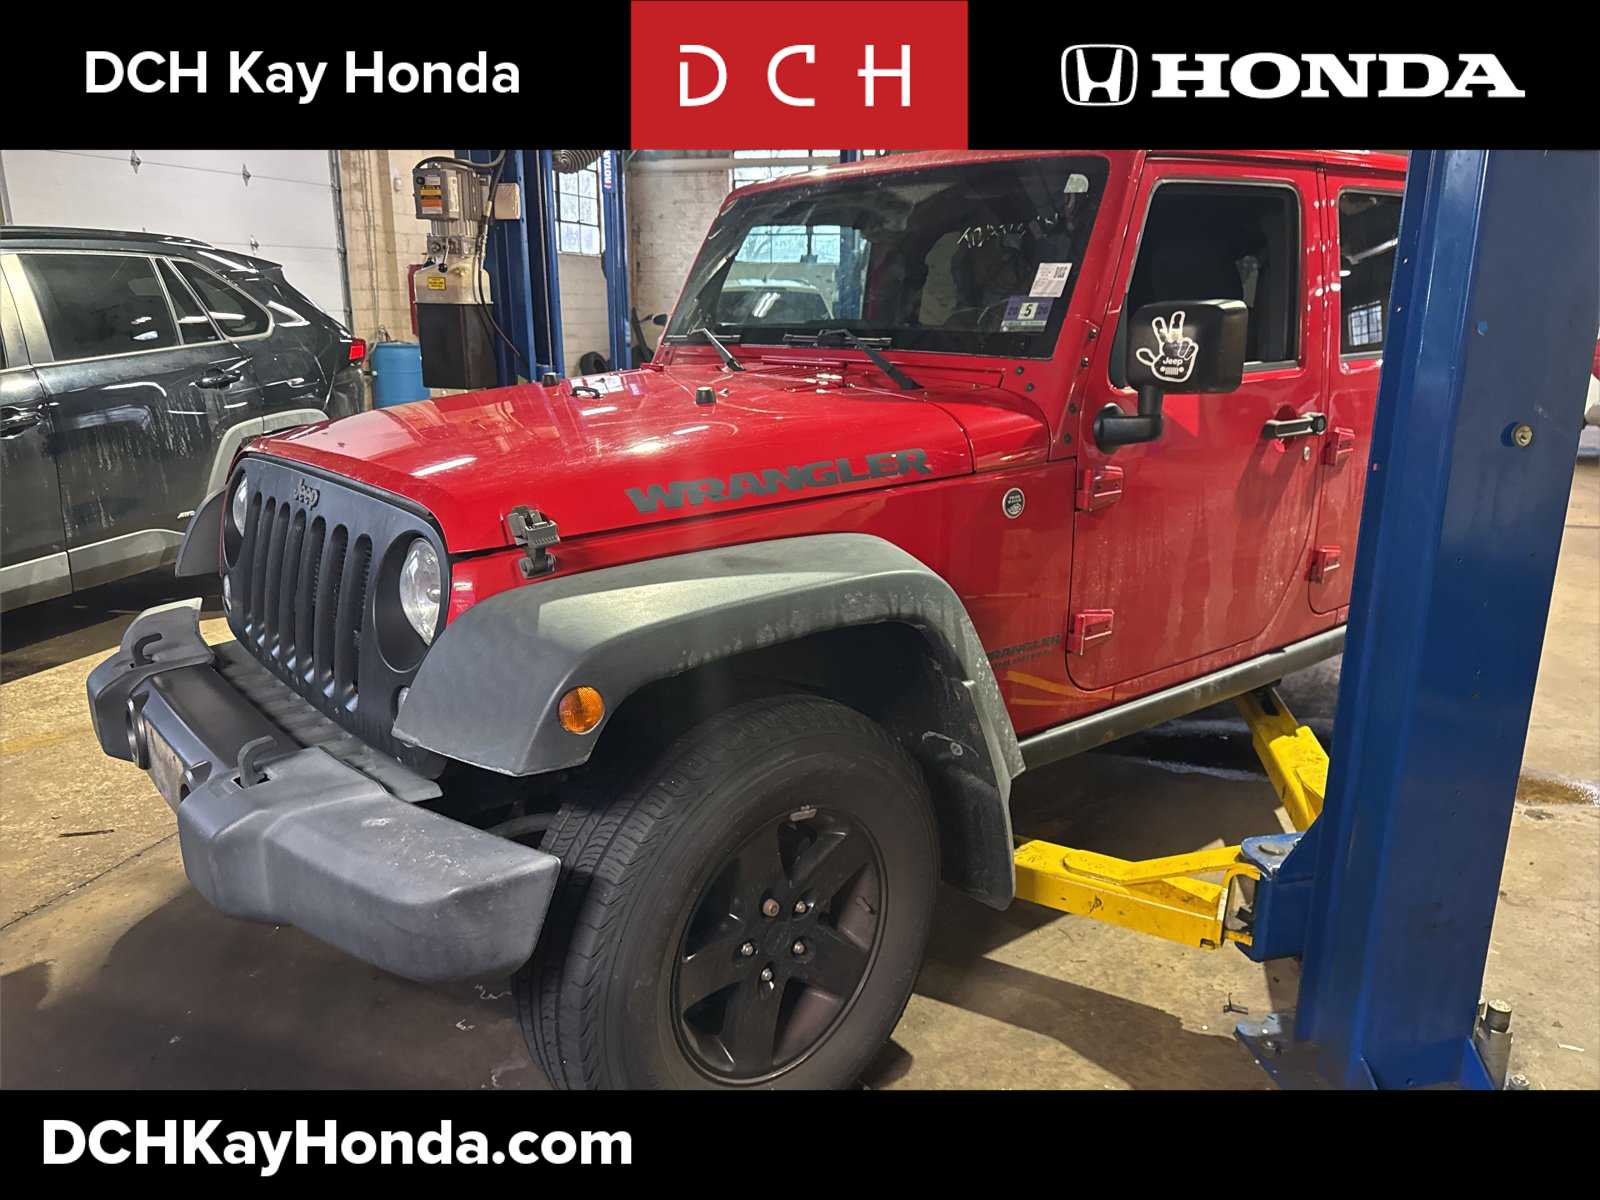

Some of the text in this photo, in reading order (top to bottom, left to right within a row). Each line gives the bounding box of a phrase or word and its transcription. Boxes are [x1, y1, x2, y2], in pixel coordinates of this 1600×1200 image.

[1023, 303, 1033, 317] 5
[1162, 356, 1184, 367] Jeep
[624, 447, 935, 514] WRANGLER
[294, 478, 320, 511] Jeep
